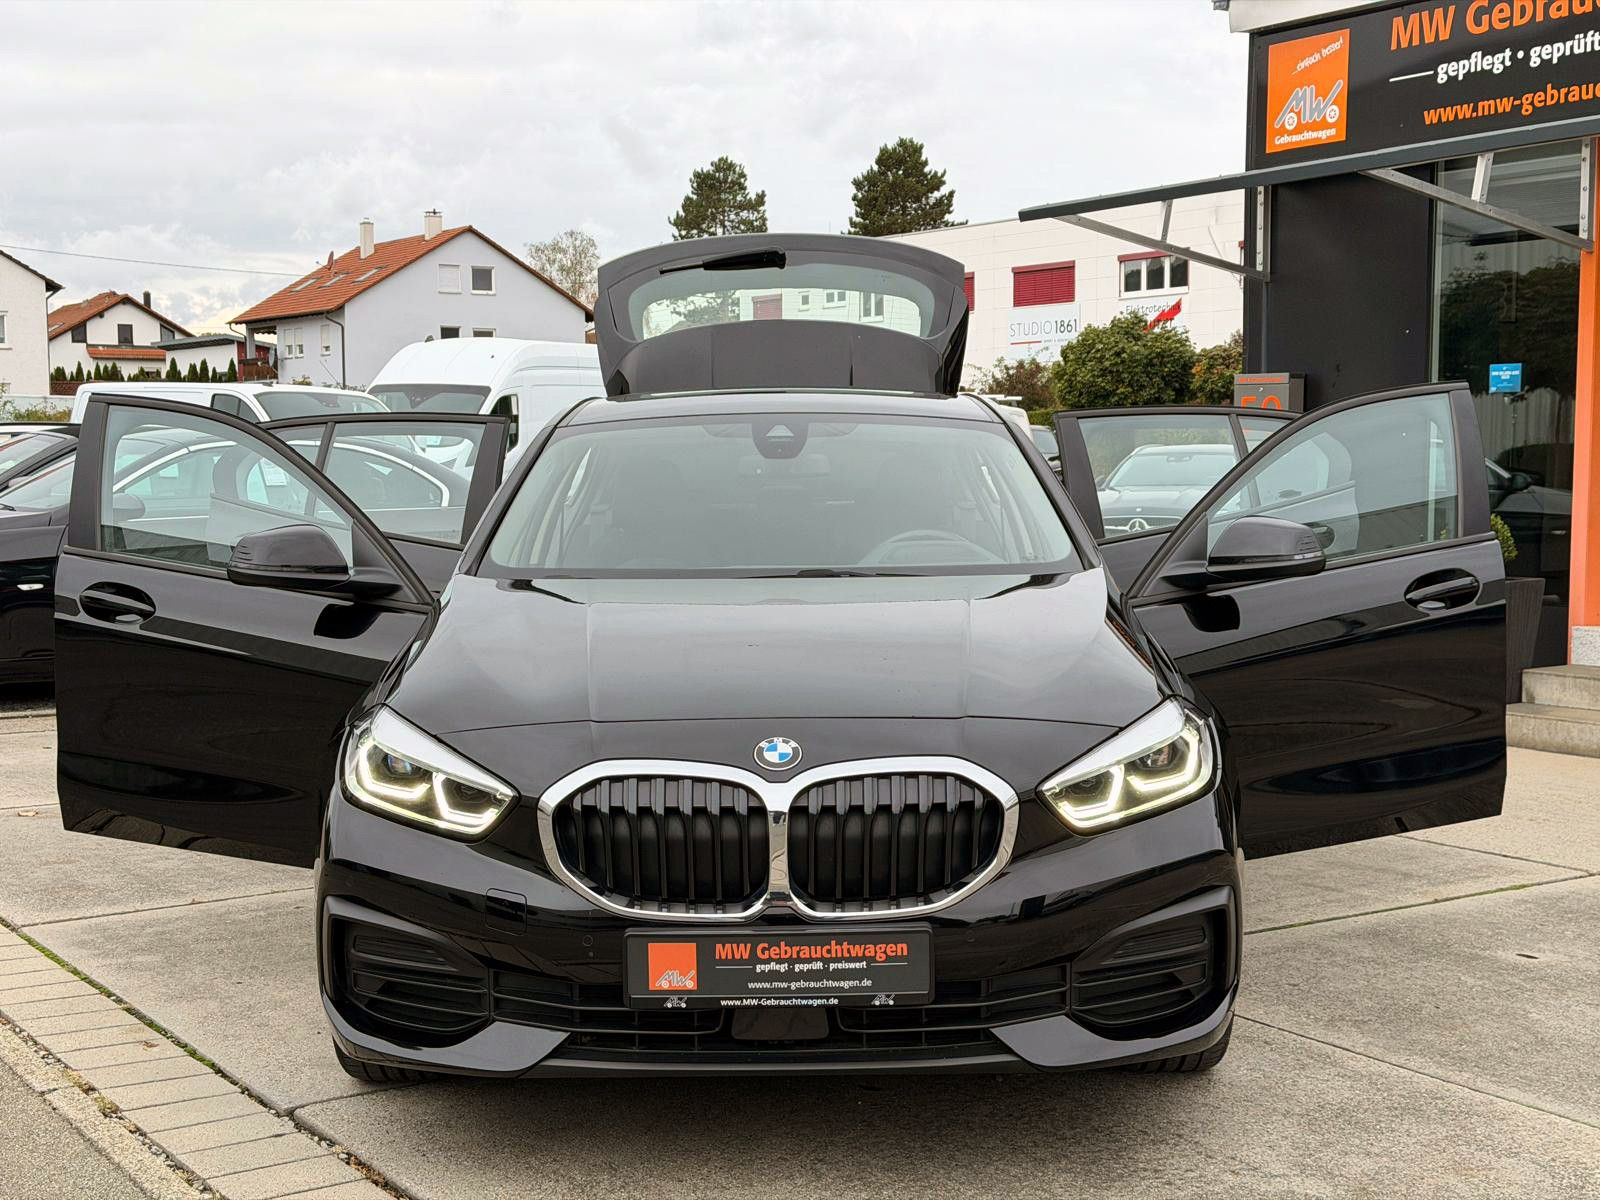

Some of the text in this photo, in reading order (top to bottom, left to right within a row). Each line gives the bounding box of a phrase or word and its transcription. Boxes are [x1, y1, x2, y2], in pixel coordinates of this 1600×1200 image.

[1391, 0, 1600, 50] MW Gebrau
[1437, 30, 1600, 84] gepflegt geprüft
[1275, 128, 1336, 145] Gebrauchtwagen
[1009, 318, 1078, 337] STUDIO 1861
[715, 940, 908, 961] MW Gebrauchtwagen
[755, 960, 867, 973] gepflegt geprüft preiswert
[747, 978, 873, 991] www.mw-gebrauchtwagen.de
[720, 997, 839, 1007] www.MW-Gebrauchtwagen.de
